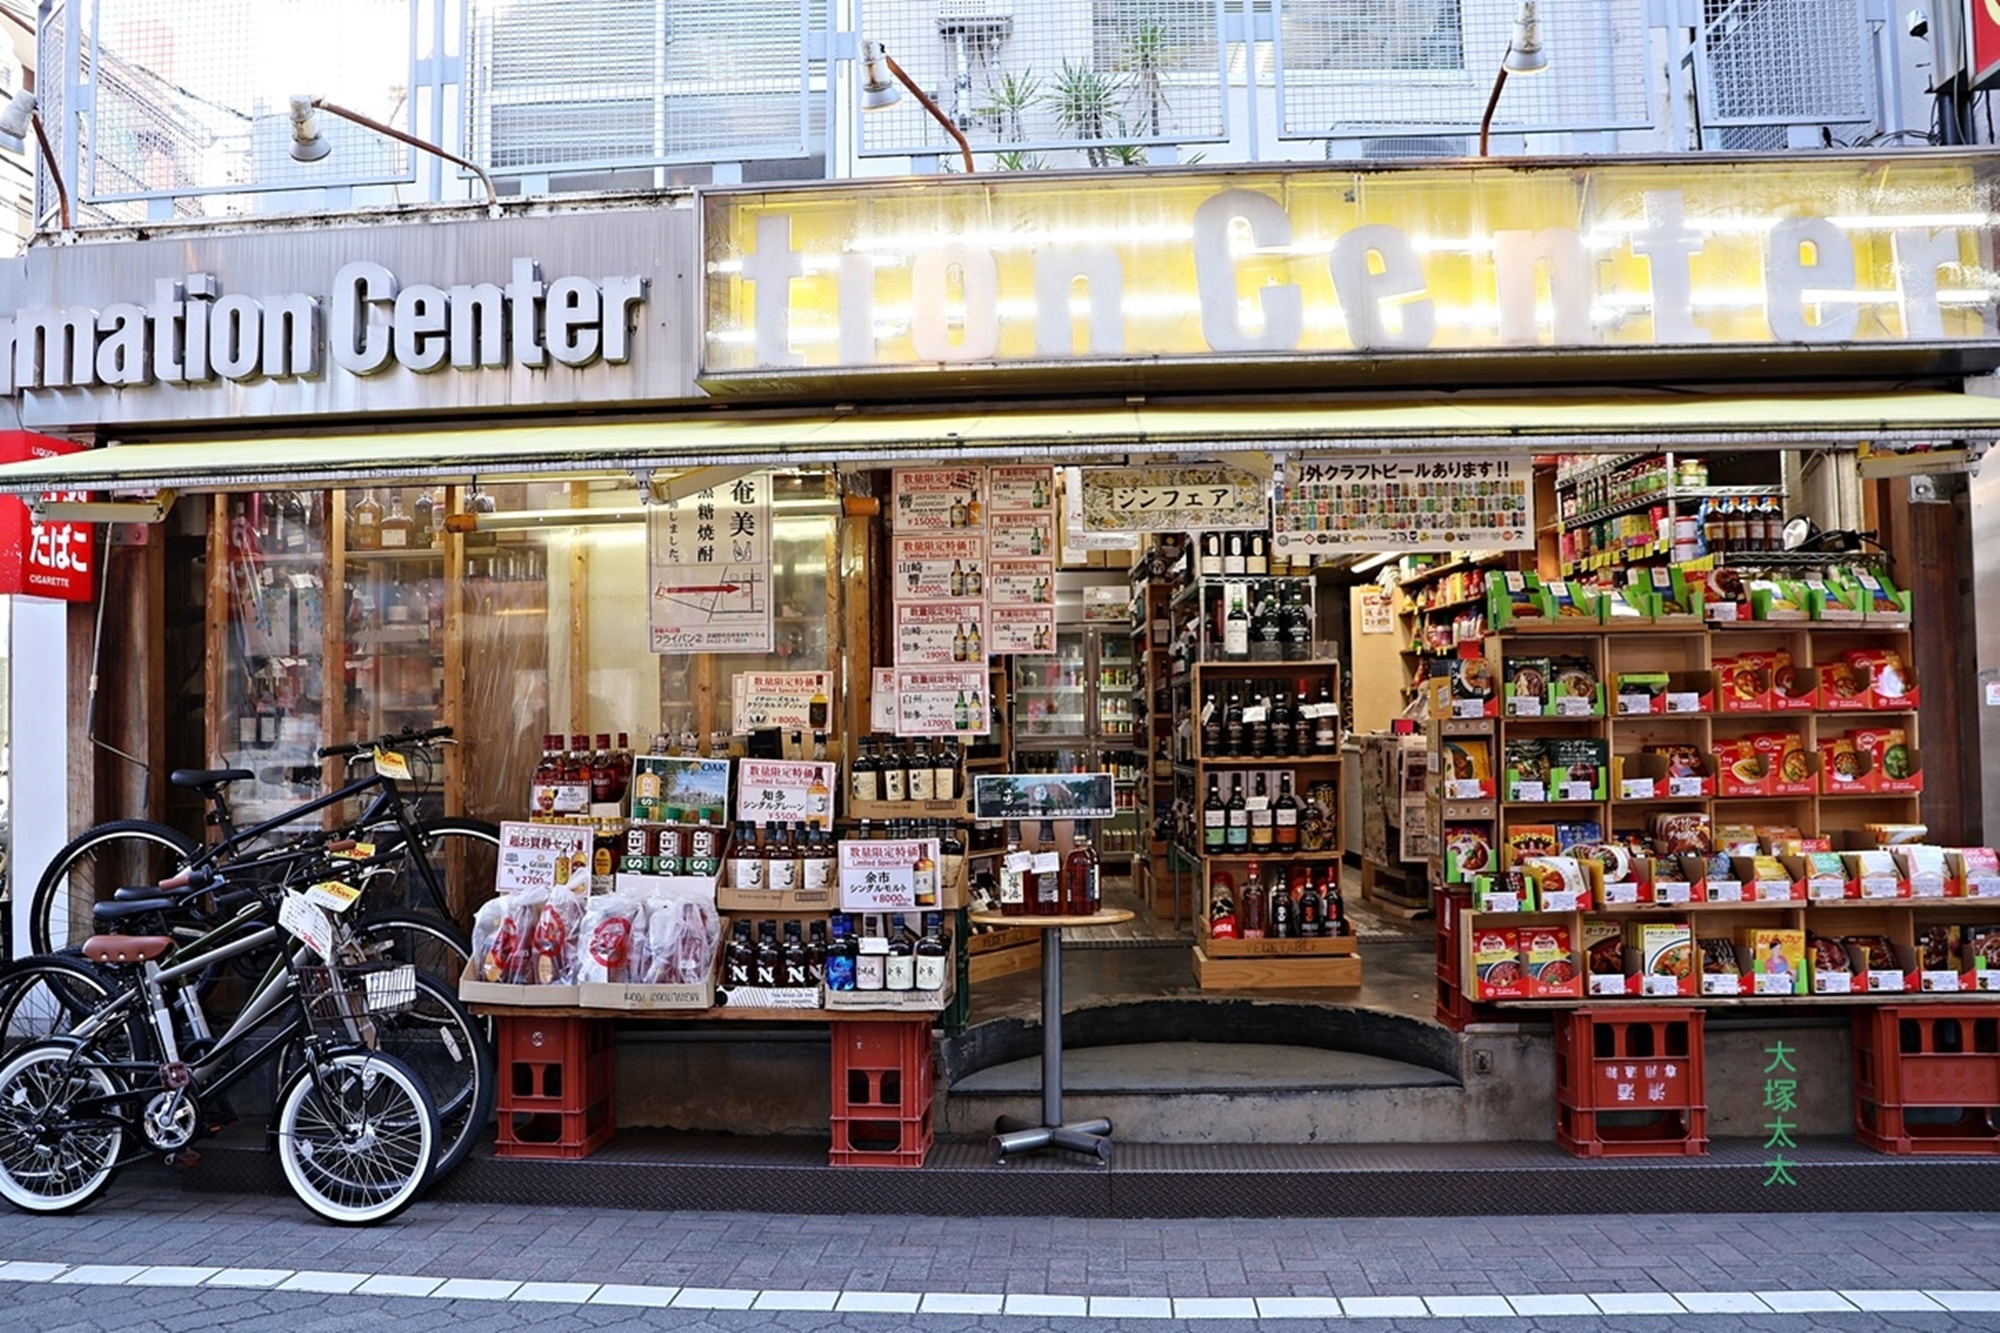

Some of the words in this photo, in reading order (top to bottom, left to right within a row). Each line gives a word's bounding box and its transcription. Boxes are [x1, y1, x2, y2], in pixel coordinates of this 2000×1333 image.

[331, 257, 650, 377] Center
[1299, 461, 1509, 482] 外クラフトビールあります!!
[1118, 487, 1229, 509] ジンフェア
[730, 480, 755, 537] 奄美
[29, 523, 87, 573] たばこ
[29, 573, 70, 588] CIGARETTE
[761, 790, 786, 801] 知多
[743, 800, 806, 811] シングルグレーン
[865, 871, 891, 884] 余市
[850, 884, 907, 894] シングルモルト
